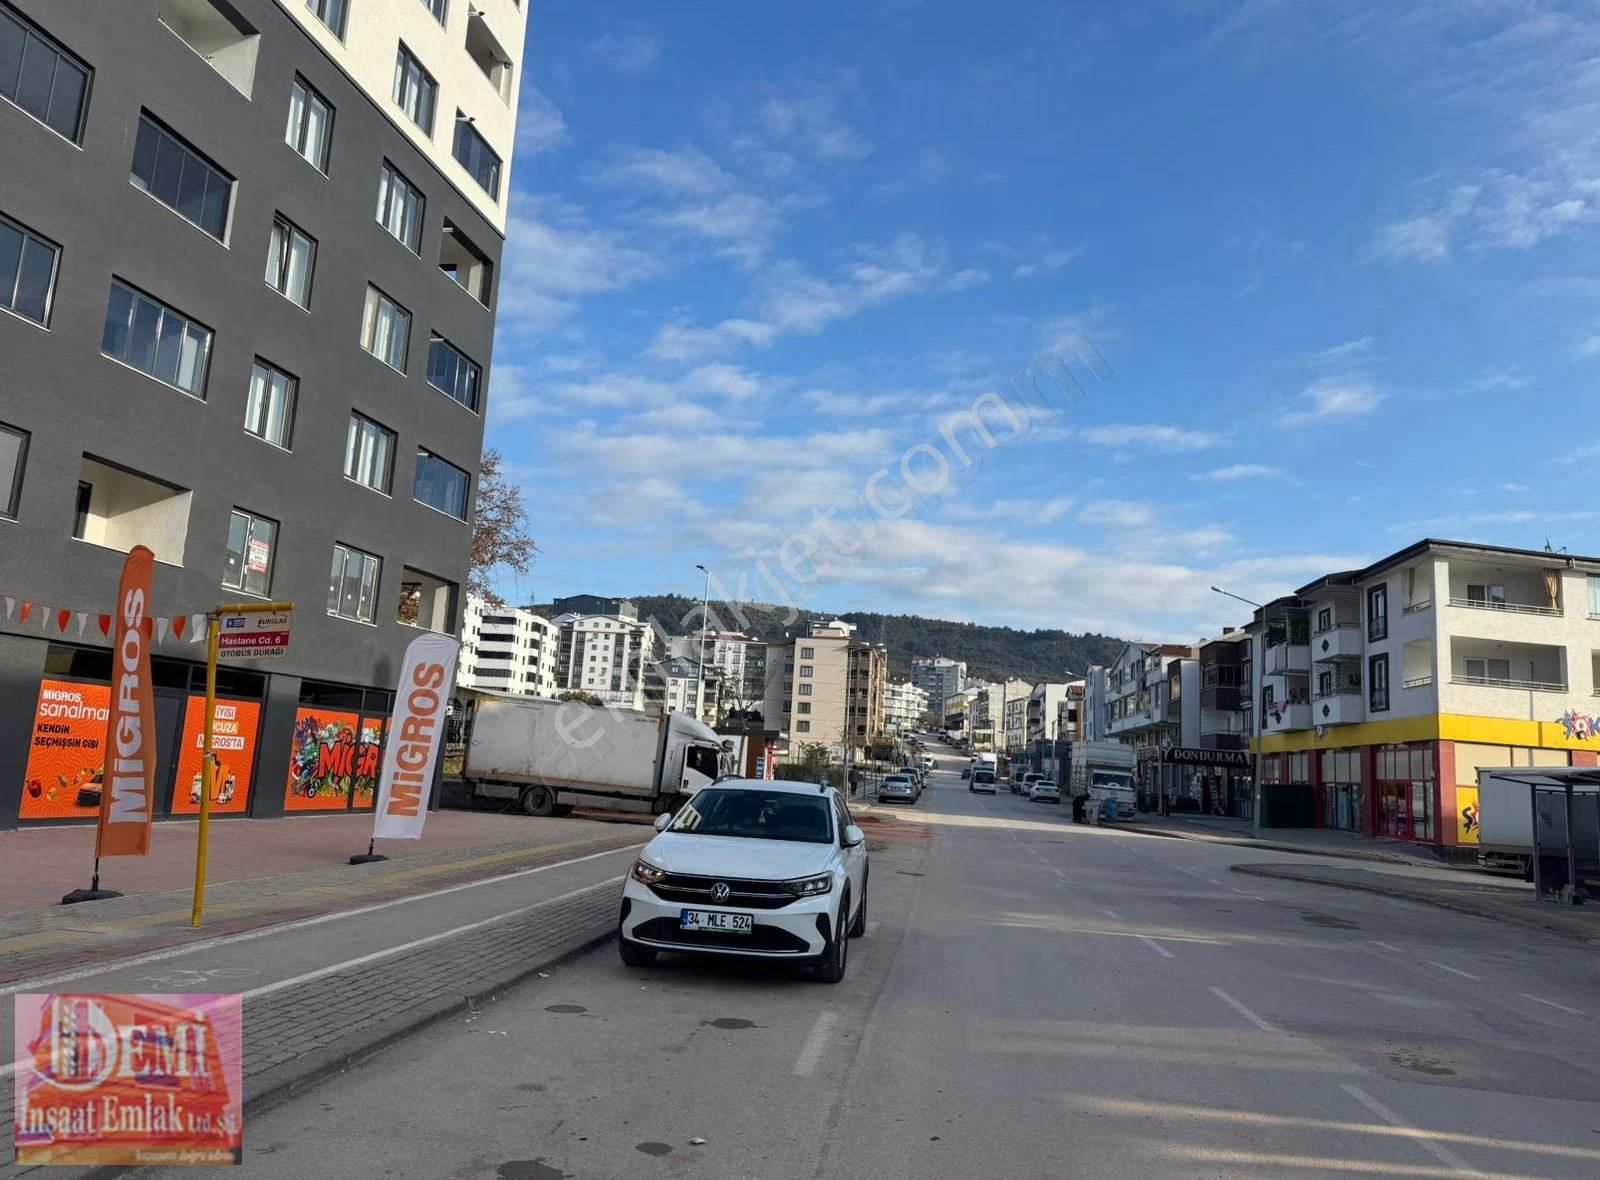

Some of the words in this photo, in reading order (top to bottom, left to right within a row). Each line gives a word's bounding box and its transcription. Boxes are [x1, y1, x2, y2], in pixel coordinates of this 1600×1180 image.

[221, 637, 256, 645] Hastane
[258, 636, 273, 645] Cd.
[275, 636, 281, 644] 6
[39, 702, 111, 720] sanalmar
[213, 721, 237, 732] CUZA
[1174, 749, 1244, 764] DONDURMA
[688, 912, 700, 926] 34
[707, 913, 727, 928] MLE
[732, 916, 751, 930] 524
